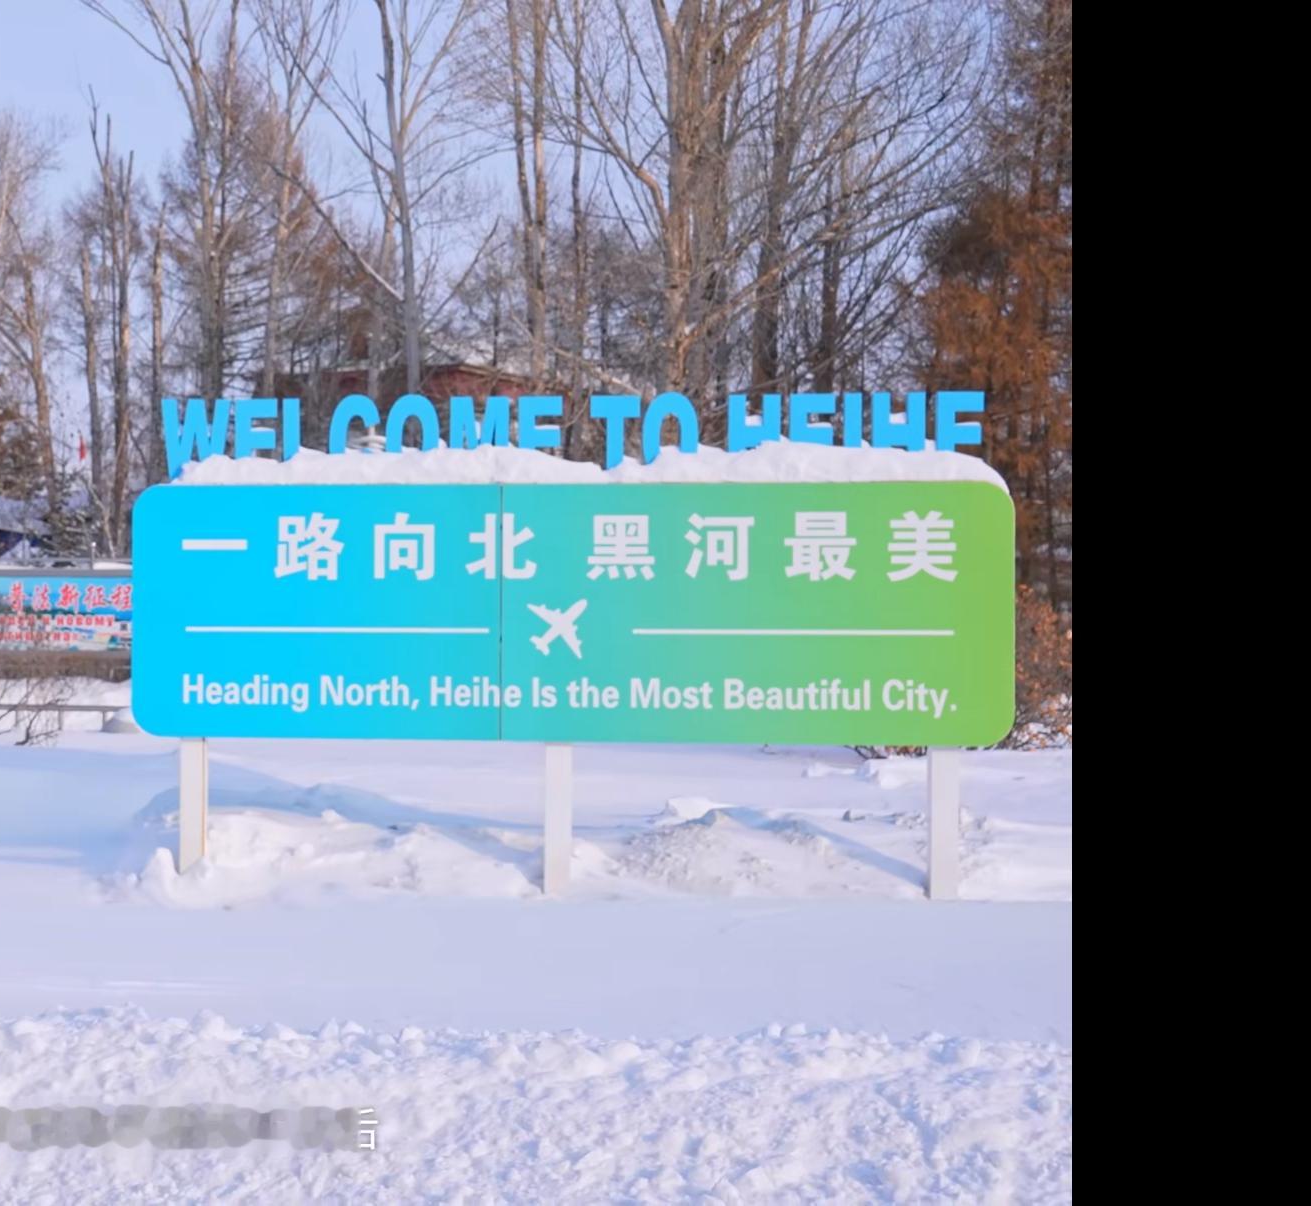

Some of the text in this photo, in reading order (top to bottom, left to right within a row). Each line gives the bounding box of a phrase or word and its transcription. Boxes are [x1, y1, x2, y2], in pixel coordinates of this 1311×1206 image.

[161, 390, 986, 479] WELCOME TO HEIHE
[181, 510, 959, 582] 一路向北 黑河最美
[181, 674, 958, 719] Heading North, Heihe Is the Most Beautiful City.
